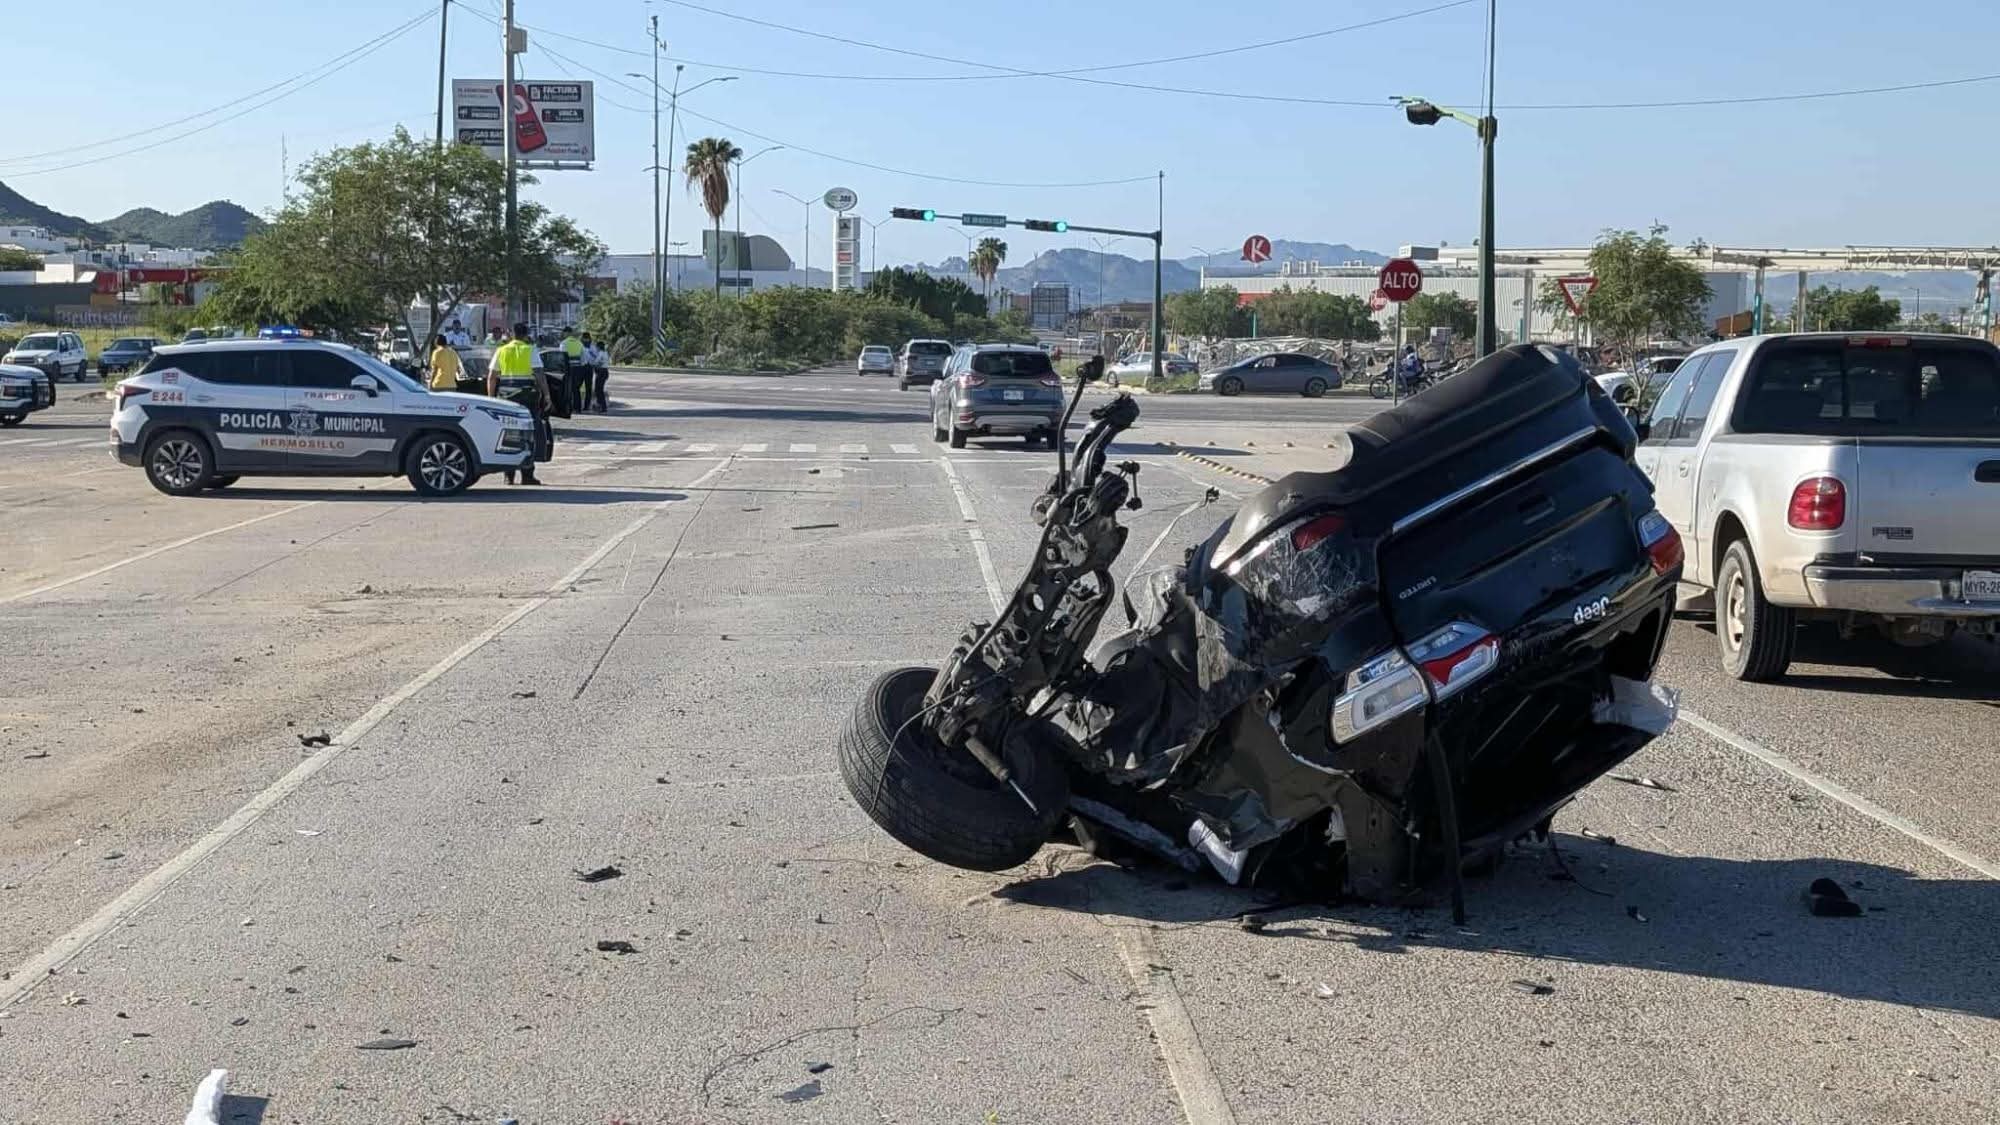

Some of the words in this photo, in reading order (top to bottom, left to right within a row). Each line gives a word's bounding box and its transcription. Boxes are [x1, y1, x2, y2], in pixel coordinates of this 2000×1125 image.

[1382, 271, 1420, 289] ALTO
[220, 412, 282, 429] POLICÍA
[323, 416, 386, 433] MUNICIPAL
[260, 437, 345, 449] HERMOSILLO
[1573, 596, 1609, 625] Jeep
